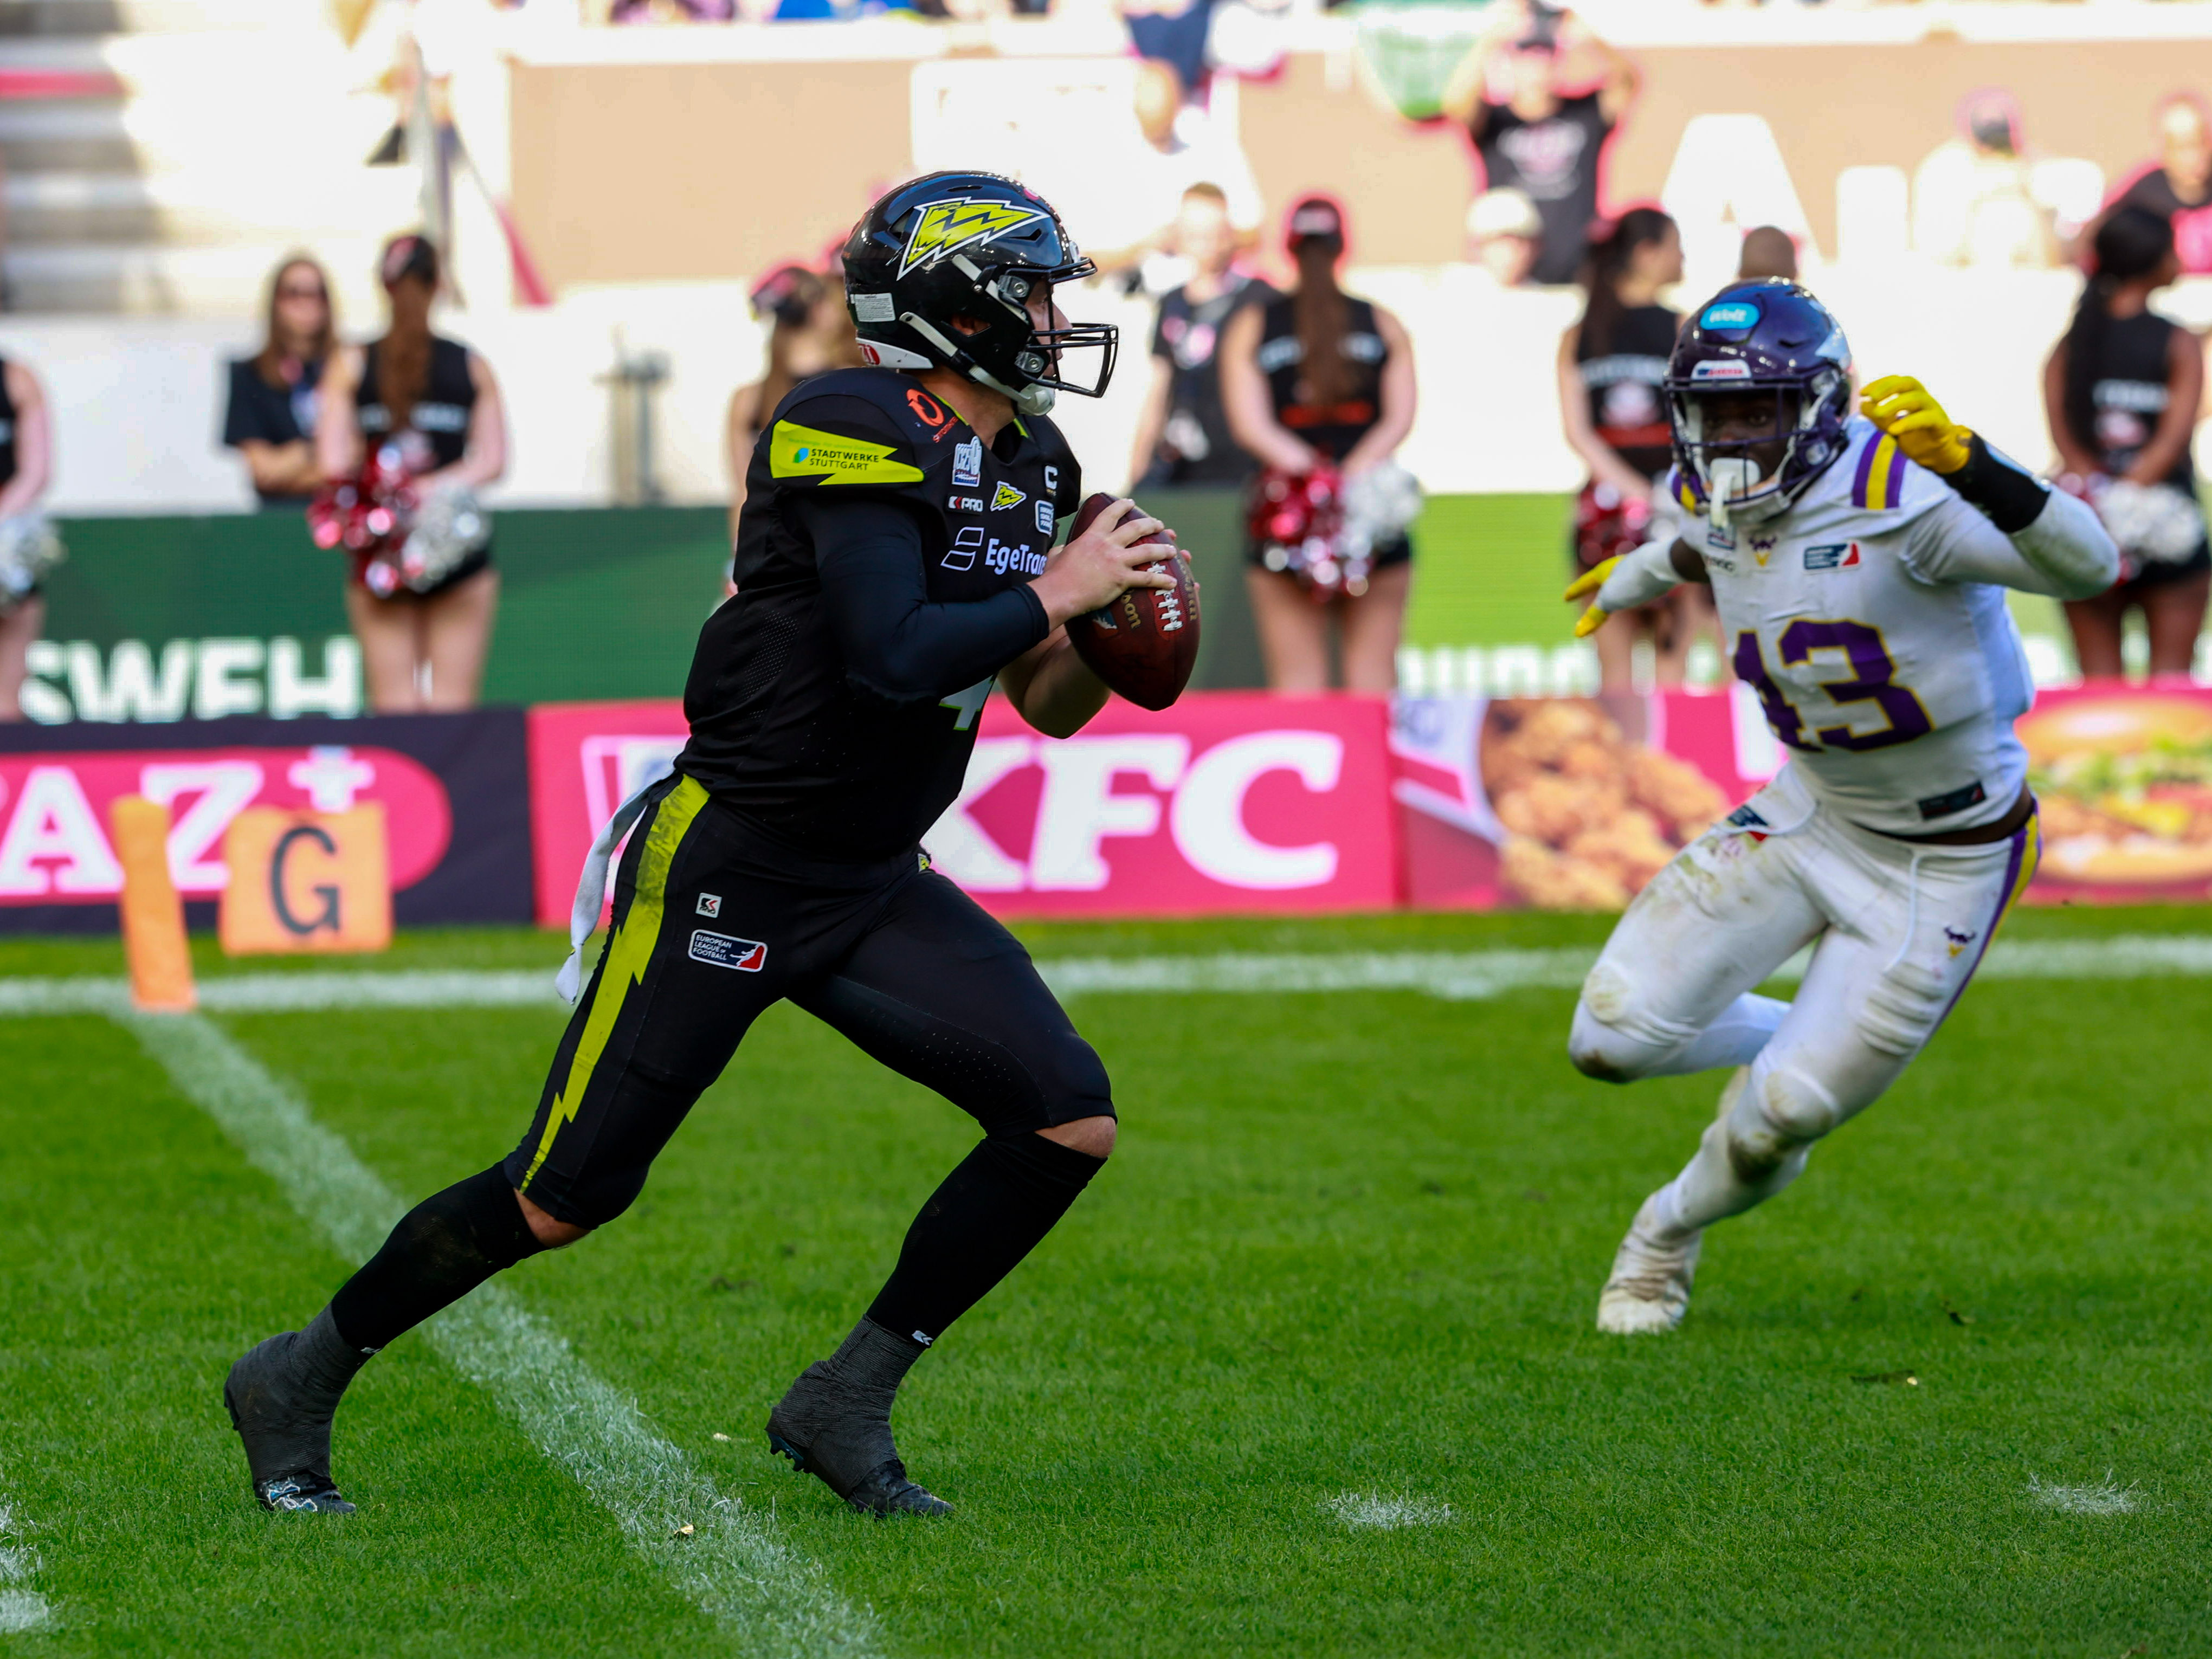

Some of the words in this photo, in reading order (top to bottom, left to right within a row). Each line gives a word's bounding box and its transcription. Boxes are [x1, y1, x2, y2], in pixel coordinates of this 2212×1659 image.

[811, 448, 880, 462] STADTWERKE
[809, 458, 869, 470] STUTTGART
[1044, 465, 1058, 490] C
[984, 538, 1048, 575] EgeTran
[921, 729, 1344, 890] KFC
[270, 824, 341, 936] G
[694, 941, 721, 952] LEAGUE
[696, 934, 732, 948] EUROPEAN
[693, 947, 727, 960] FOOTBALL
